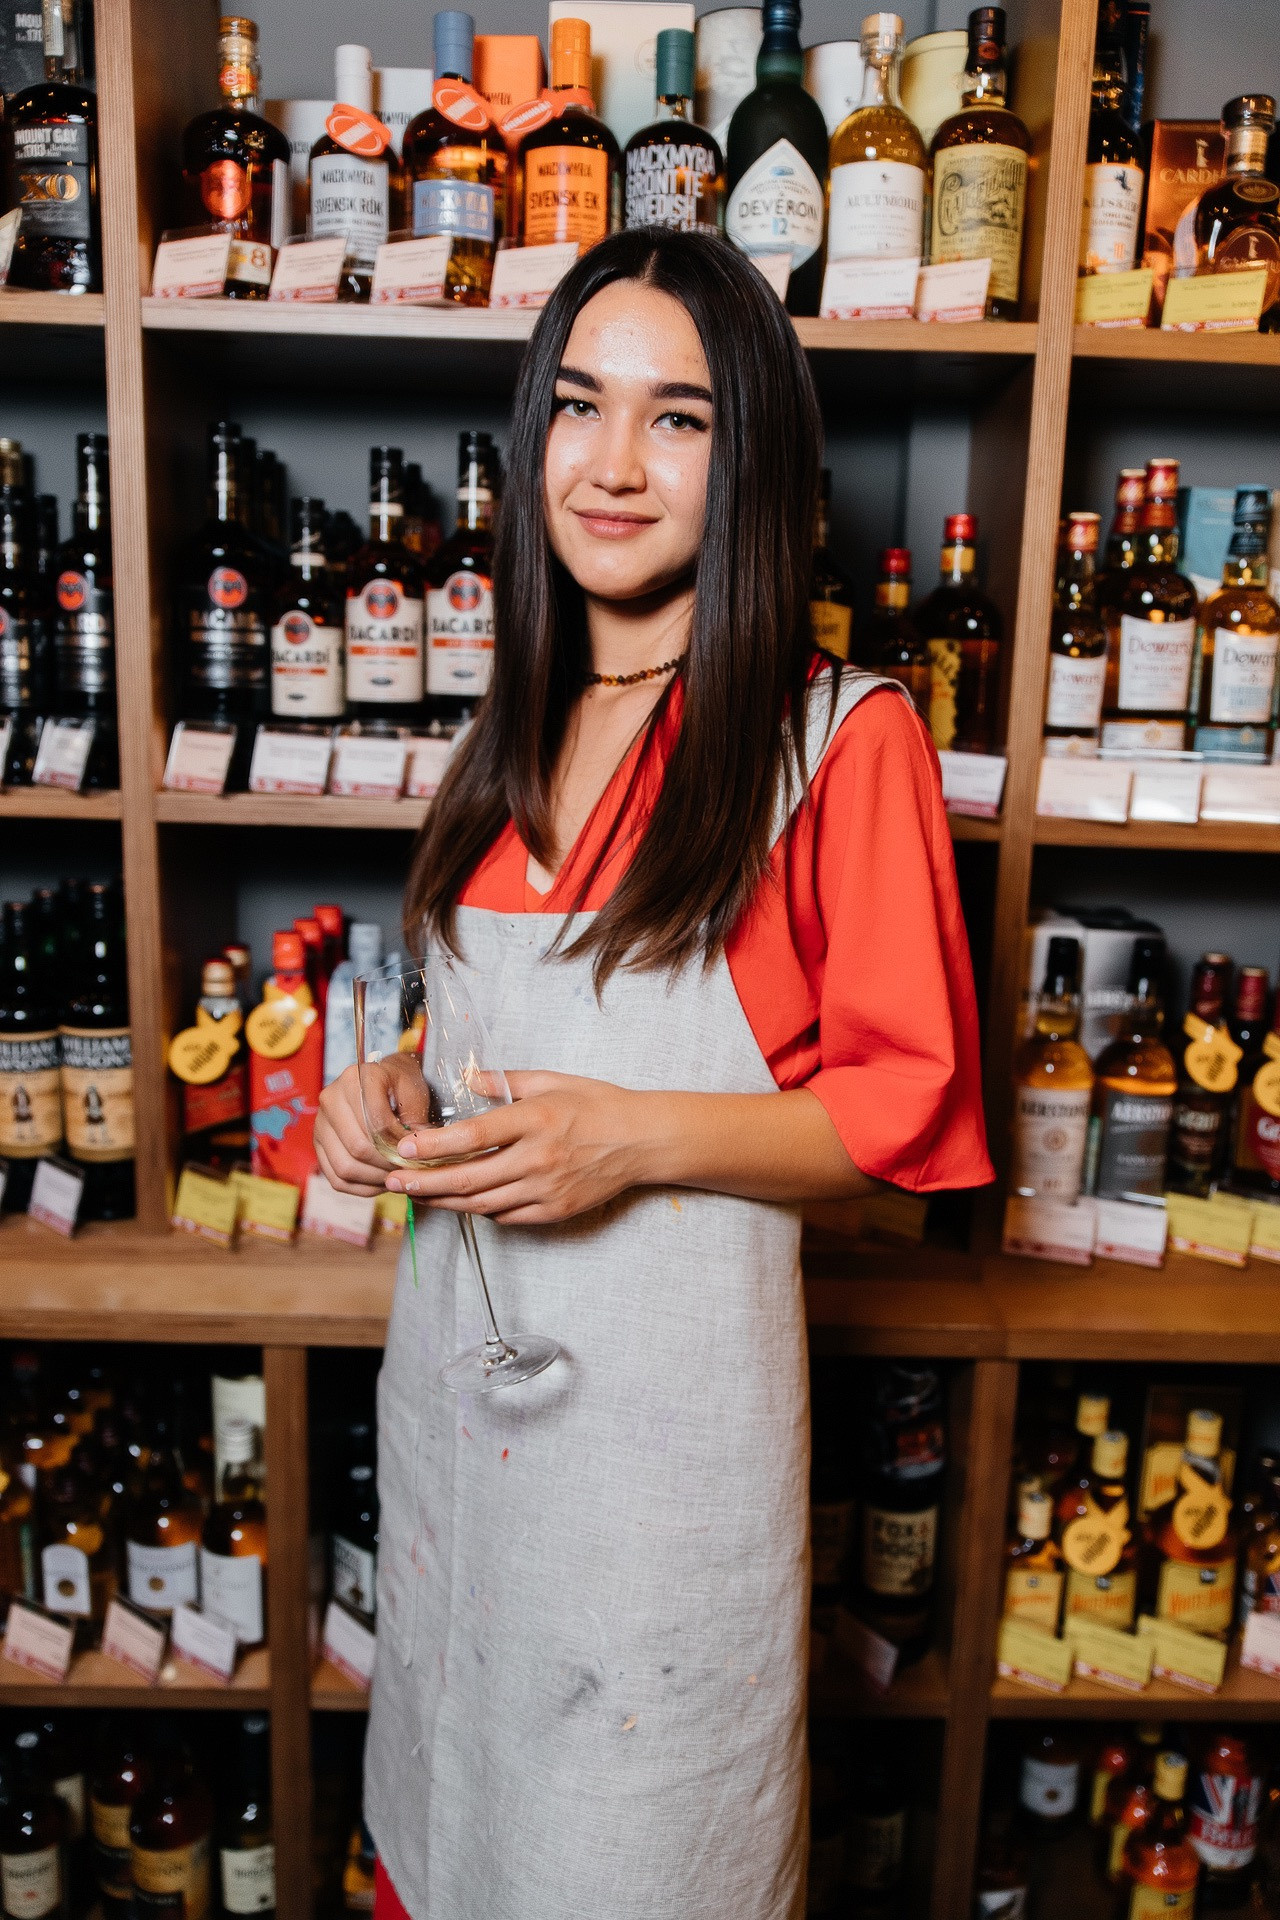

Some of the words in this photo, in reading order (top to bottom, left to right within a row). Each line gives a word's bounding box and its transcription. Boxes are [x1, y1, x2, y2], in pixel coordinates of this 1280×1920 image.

[14, 128, 52, 145] MOUNT
[53, 128, 78, 143] GAY
[626, 144, 716, 176] MACKMYRA
[19, 173, 80, 202] XO
